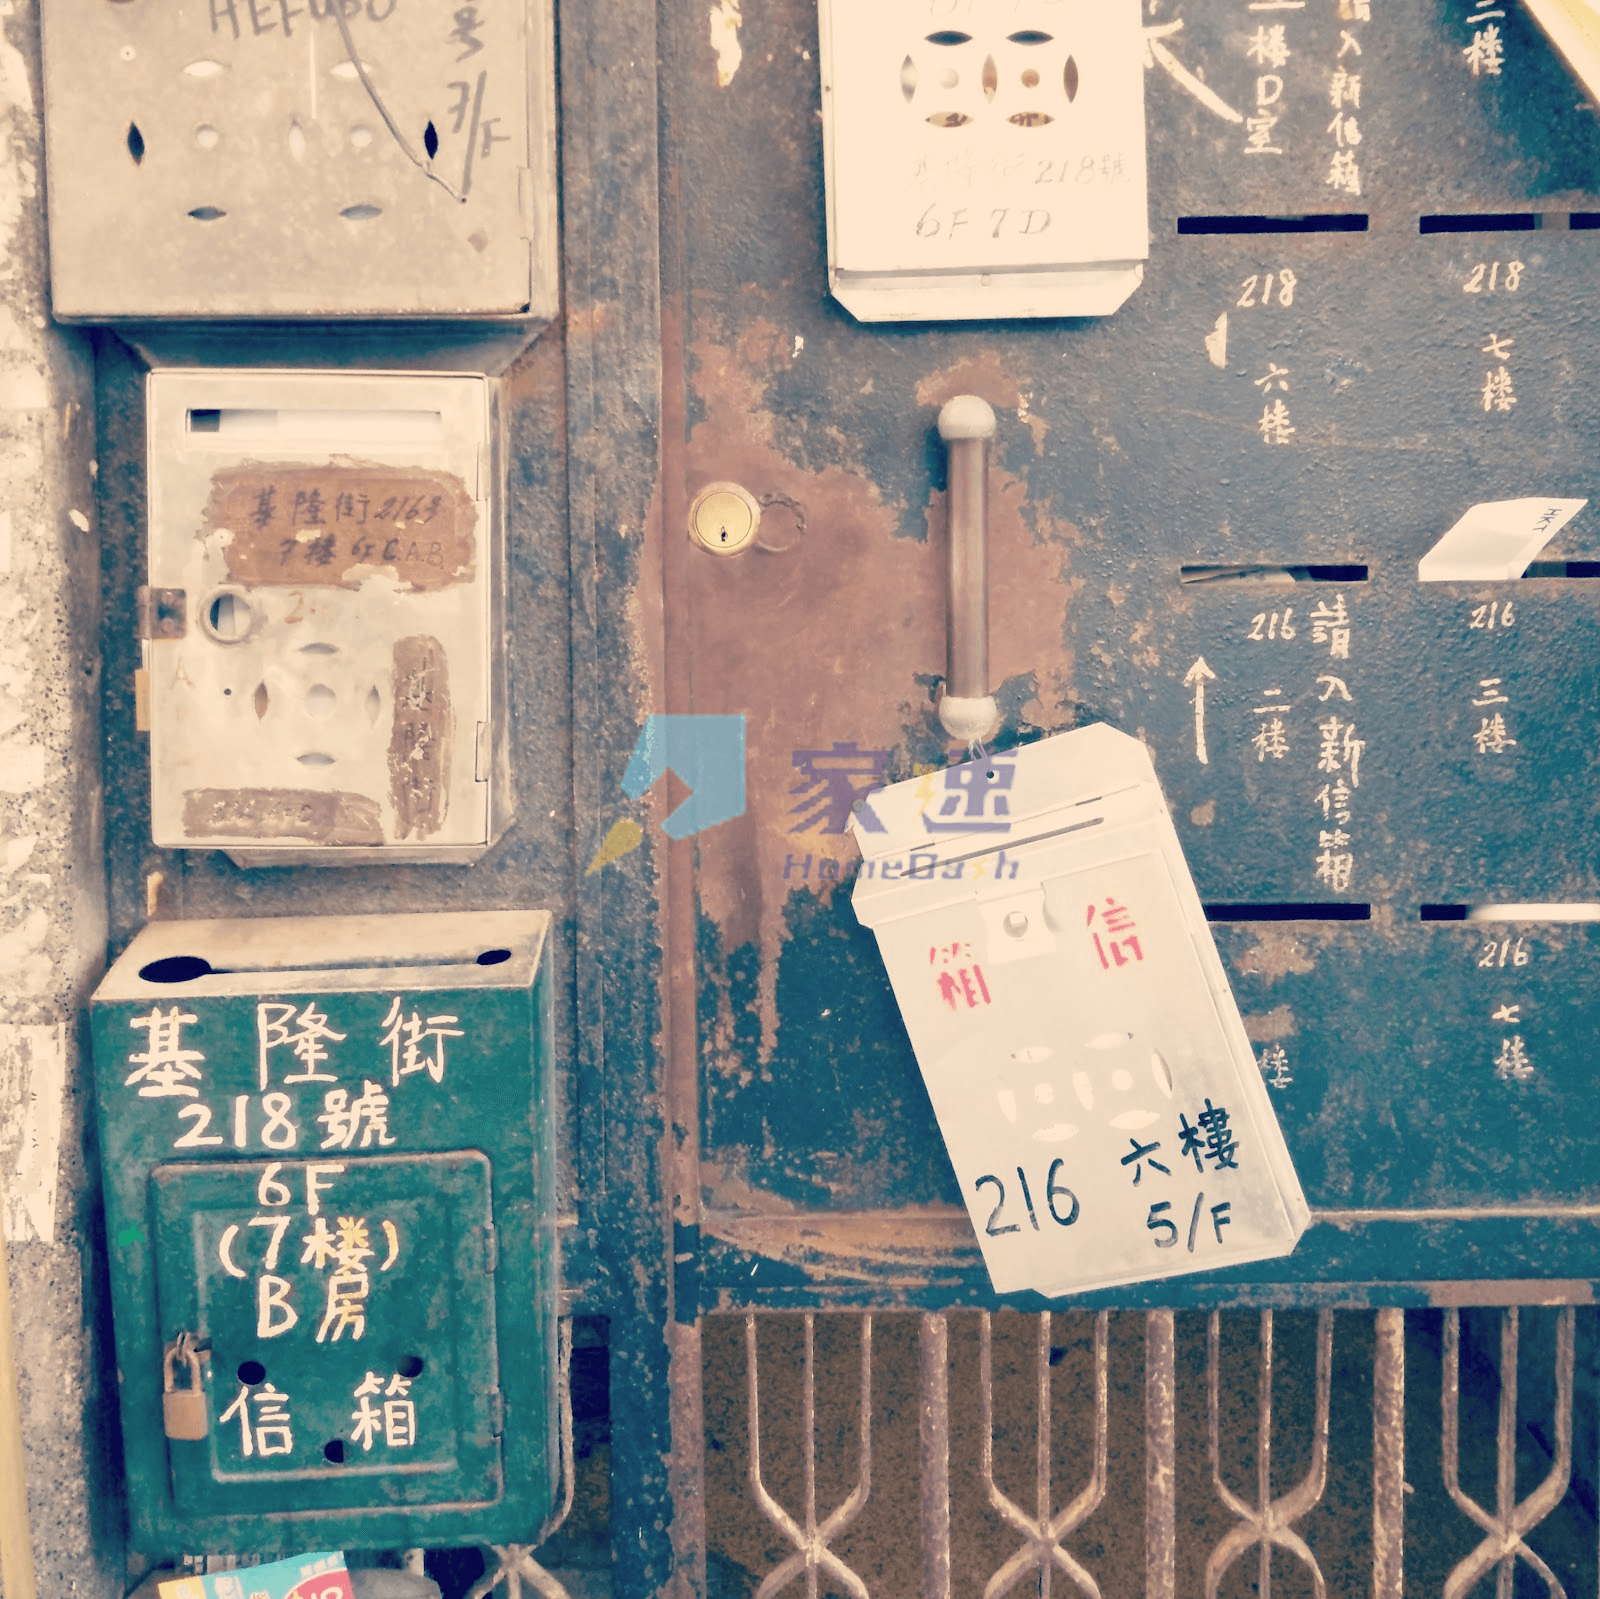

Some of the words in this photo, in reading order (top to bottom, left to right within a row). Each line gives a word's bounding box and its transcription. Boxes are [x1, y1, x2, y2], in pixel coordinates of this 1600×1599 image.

[1237, 269, 1297, 308] 218
[1463, 261, 1525, 293] 218
[1248, 608, 1296, 640] 216
[1469, 602, 1516, 630] 216
[1475, 940, 1529, 968] 216
[125, 996, 466, 1097] 基隆街
[258, 1162, 345, 1216] 6F
[974, 1157, 1081, 1239] 216
[1146, 1191, 1232, 1253] 5/F
[219, 1371, 417, 1457] 信箱
